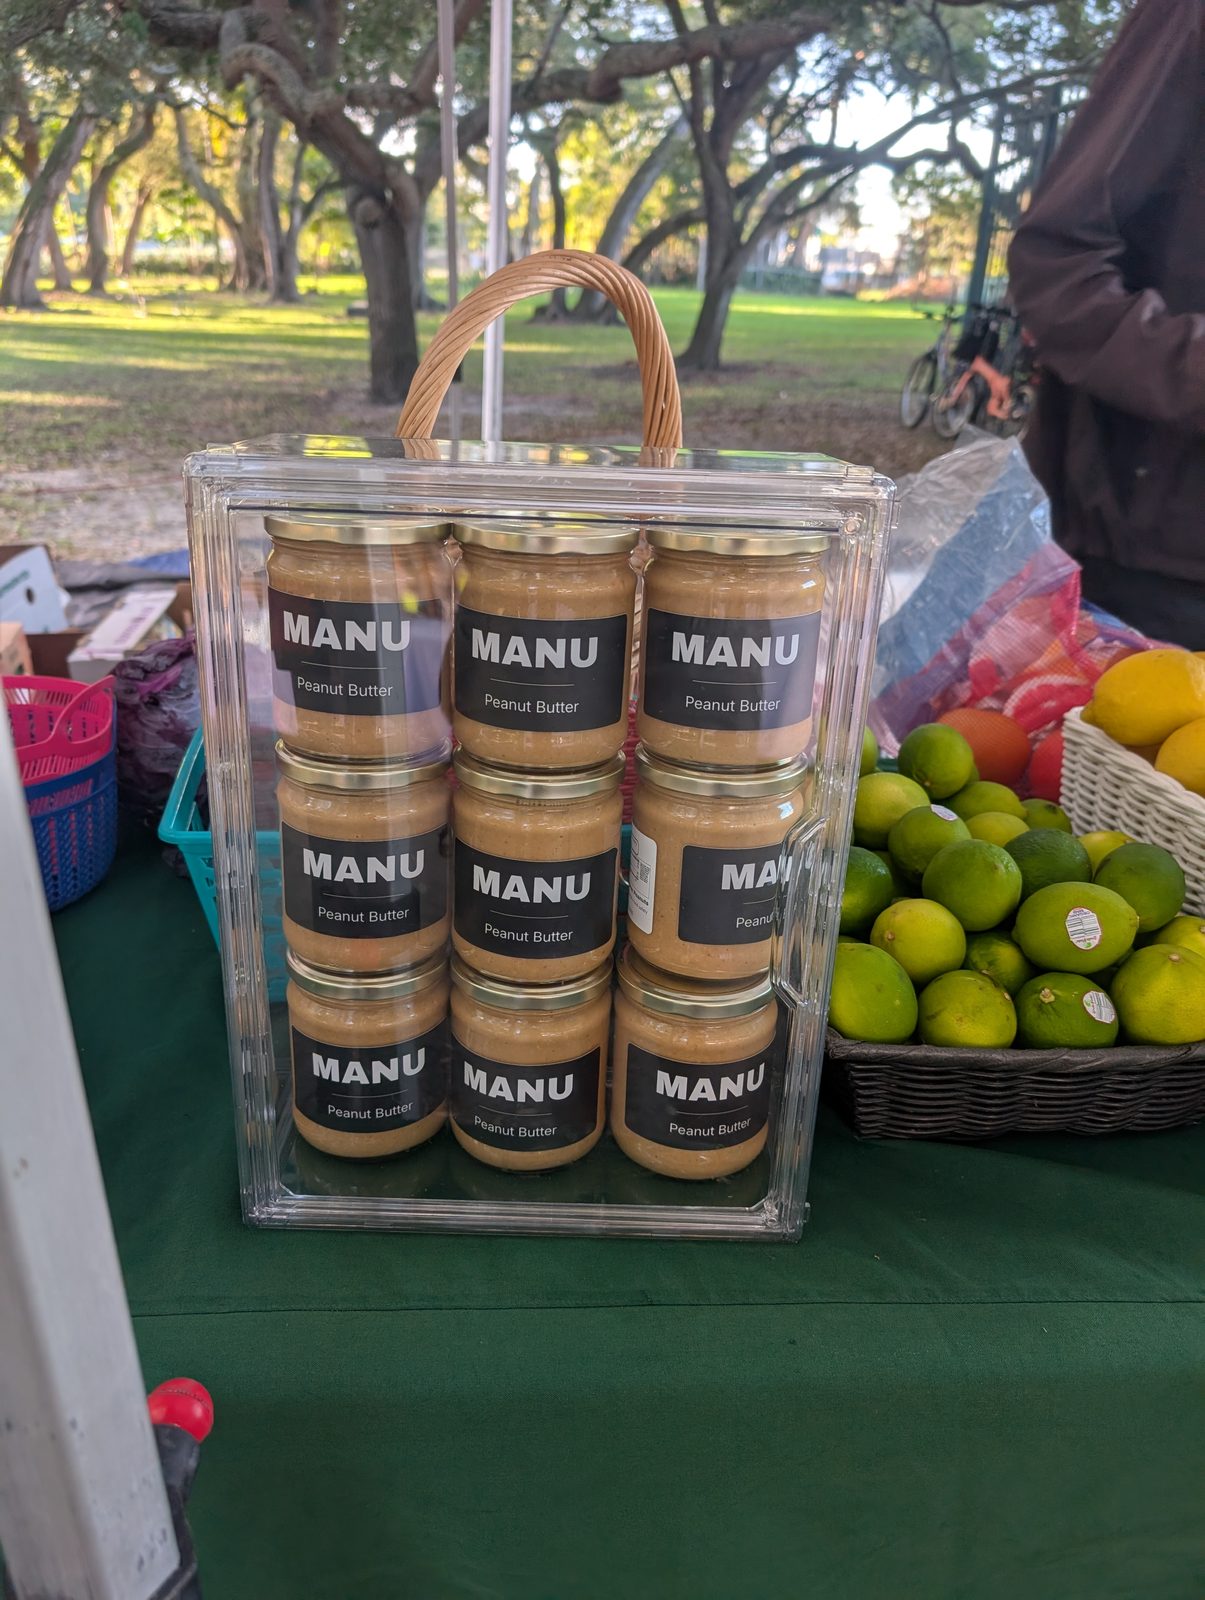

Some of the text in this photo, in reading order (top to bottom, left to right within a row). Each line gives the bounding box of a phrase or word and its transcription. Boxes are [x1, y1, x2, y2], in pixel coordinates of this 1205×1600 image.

[283, 611, 411, 652] MANU
[471, 628, 599, 669] MANU
[671, 632, 800, 668] MANU
[297, 676, 393, 698] Peanut Butter
[484, 693, 580, 715] Peanut Butter
[685, 695, 781, 714] Peanut Butter
[303, 848, 425, 884] MANU
[721, 854, 793, 890] MAN
[472, 865, 591, 903] MANU
[318, 906, 410, 923] Peanut Butter
[736, 913, 775, 929] Peanu
[484, 923, 574, 944] Peanut Butter
[312, 1048, 426, 1085] MANU
[463, 1061, 574, 1103] MANU
[655, 1062, 766, 1101] MANU
[327, 1101, 414, 1120] Peanut Butter
[474, 1115, 558, 1138] Peanut Butter
[669, 1117, 752, 1137] Peanut Butter
